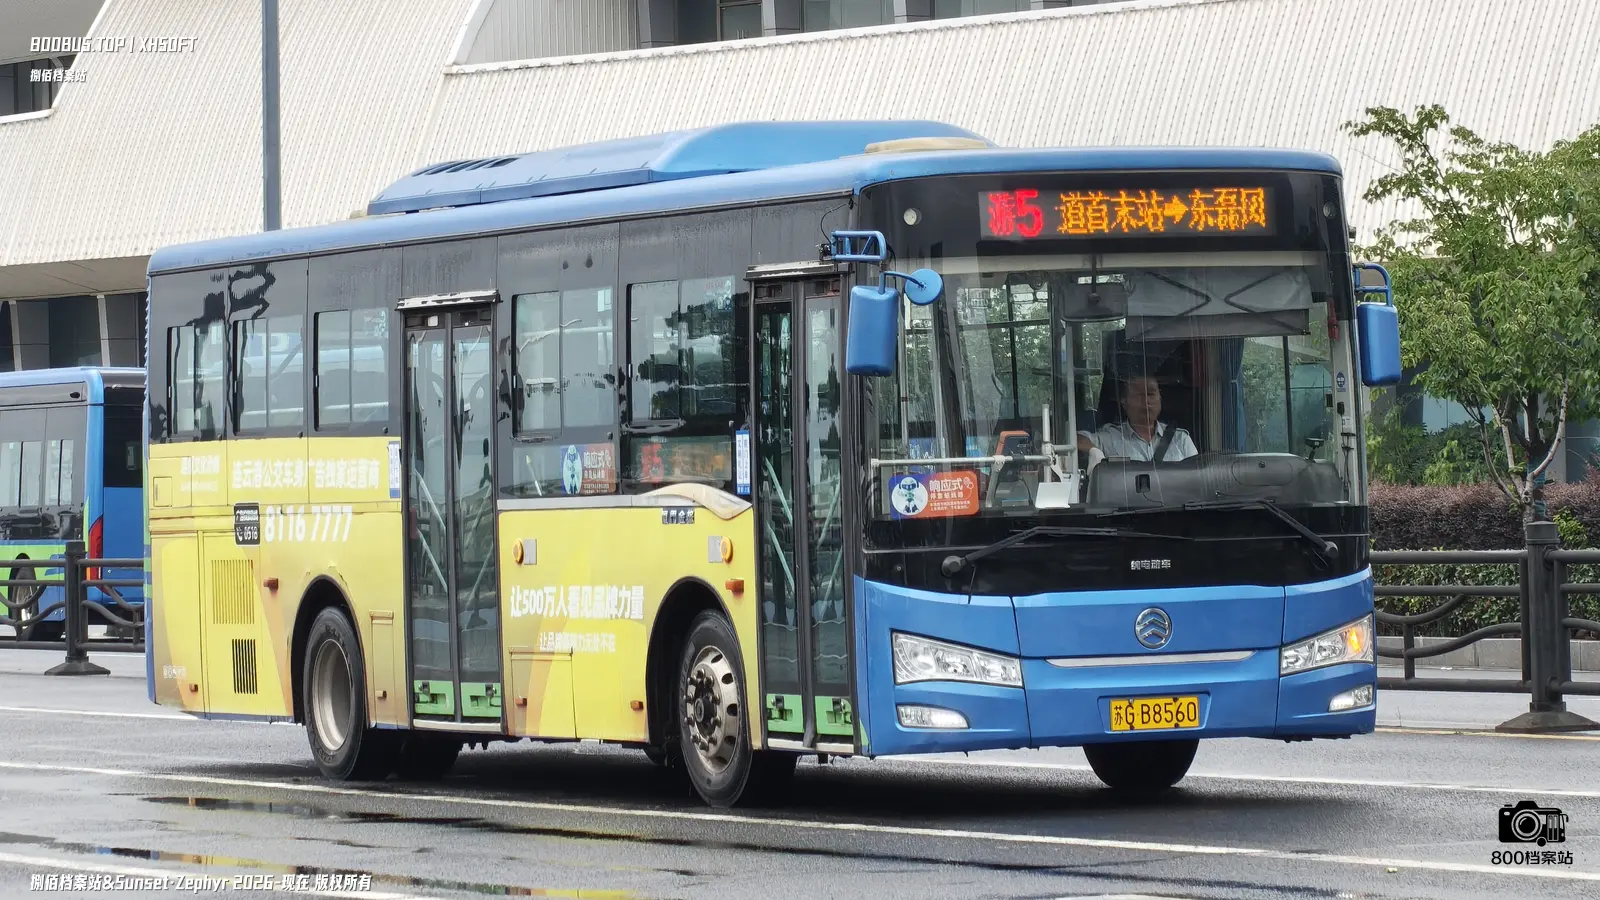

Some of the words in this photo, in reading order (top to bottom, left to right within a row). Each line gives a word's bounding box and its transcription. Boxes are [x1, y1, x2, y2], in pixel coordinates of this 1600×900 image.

[929, 478, 963, 492] 响应式
[265, 505, 306, 543] 8116
[311, 505, 352, 542] 7777
[510, 585, 644, 619] 让500万人看见品牌力量
